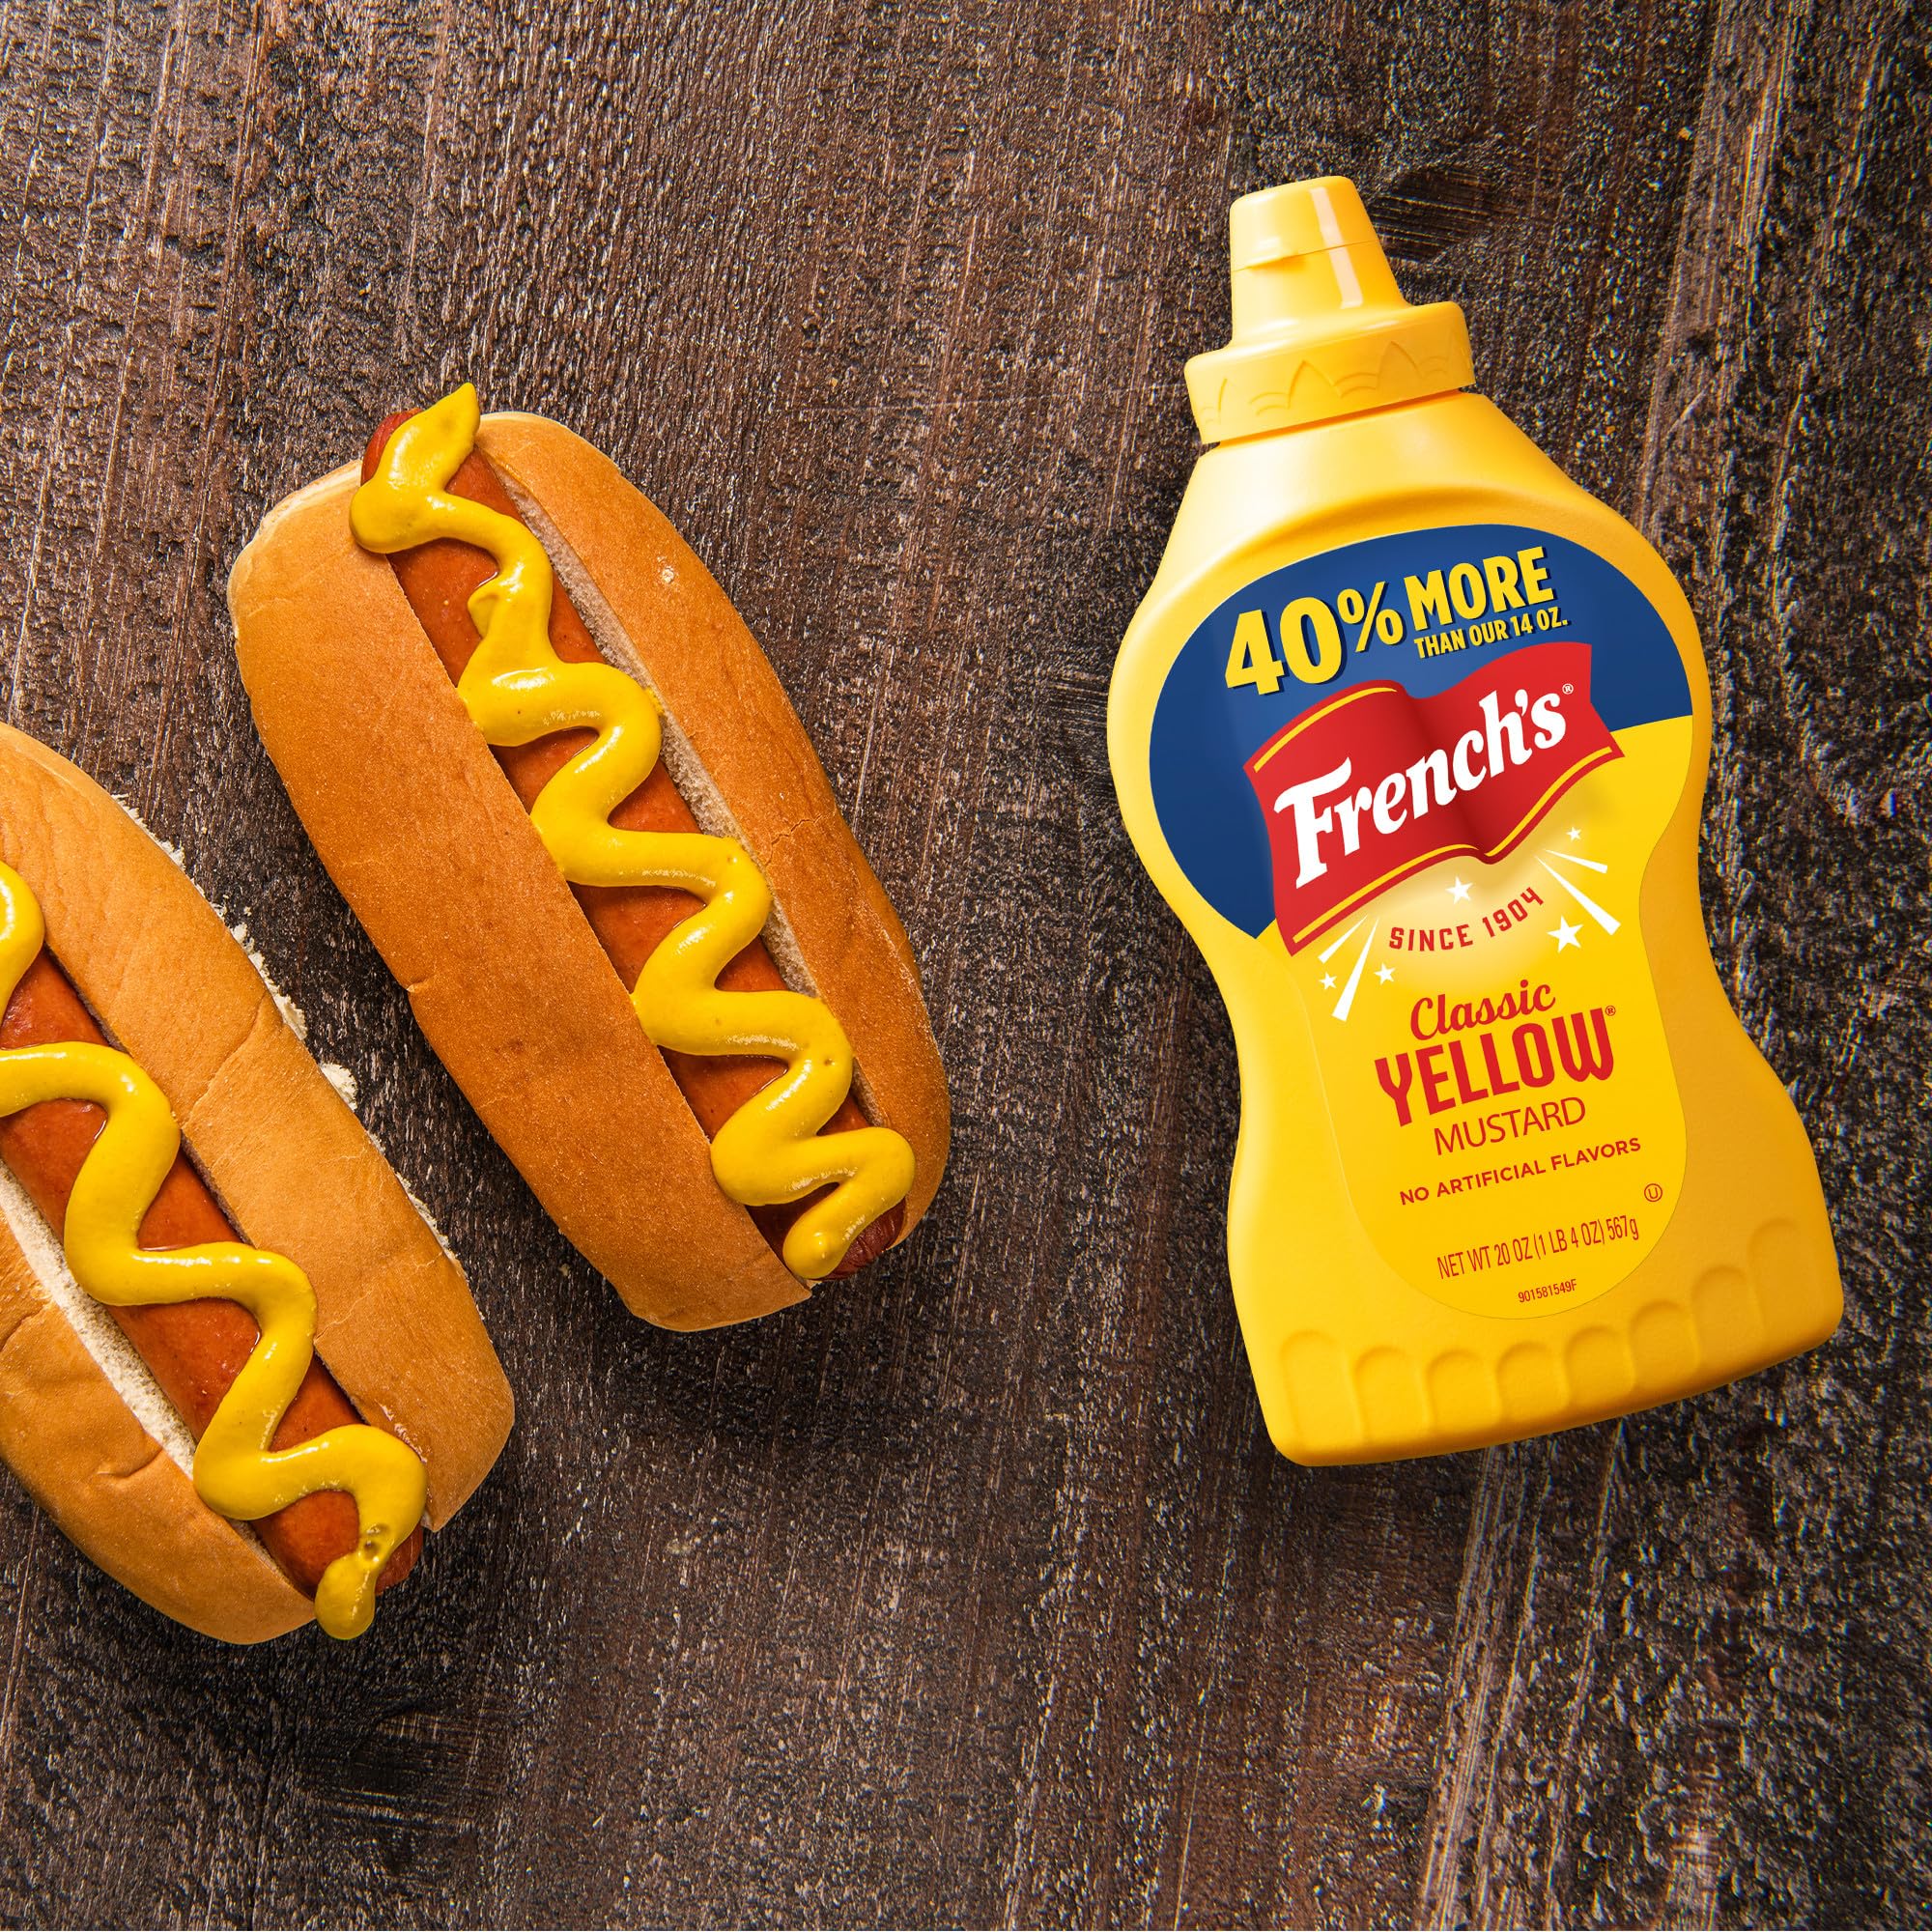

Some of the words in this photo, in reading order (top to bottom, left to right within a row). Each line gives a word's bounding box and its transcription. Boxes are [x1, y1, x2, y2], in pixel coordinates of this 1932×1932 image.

[1225, 582, 1404, 695] 40%
[1404, 546, 1555, 631] MORE
[1413, 629, 1467, 659] THAN
[1470, 620, 1508, 645] OUR
[1510, 614, 1534, 638] 14
[1536, 608, 1569, 633] OZ.
[1388, 923, 1473, 952] SINCE
[1482, 887, 1545, 938] 1904
[1410, 980, 1556, 1040] Classic
[1374, 1008, 1614, 1127] YELLOW
[1434, 1096, 1586, 1155] MUSTARD
[1400, 1187, 1430, 1206] NO
[1436, 1160, 1547, 1198] ARTIFICIAL
[1550, 1137, 1641, 1171] FLAVORS
[1437, 1252, 1465, 1280] NET
[1466, 1246, 1492, 1272] WT
[1493, 1242, 1512, 1266] 20
[1513, 1236, 1533, 1262] OZ
[1533, 1233, 1547, 1260] (1
[1548, 1229, 1568, 1254] LB
[1571, 1227, 1579, 1248] 4
[1581, 1219, 1605, 1245] OZ)
[1605, 1215, 1639, 1240] 567g
[1518, 1278, 1577, 1303] 901581549F
